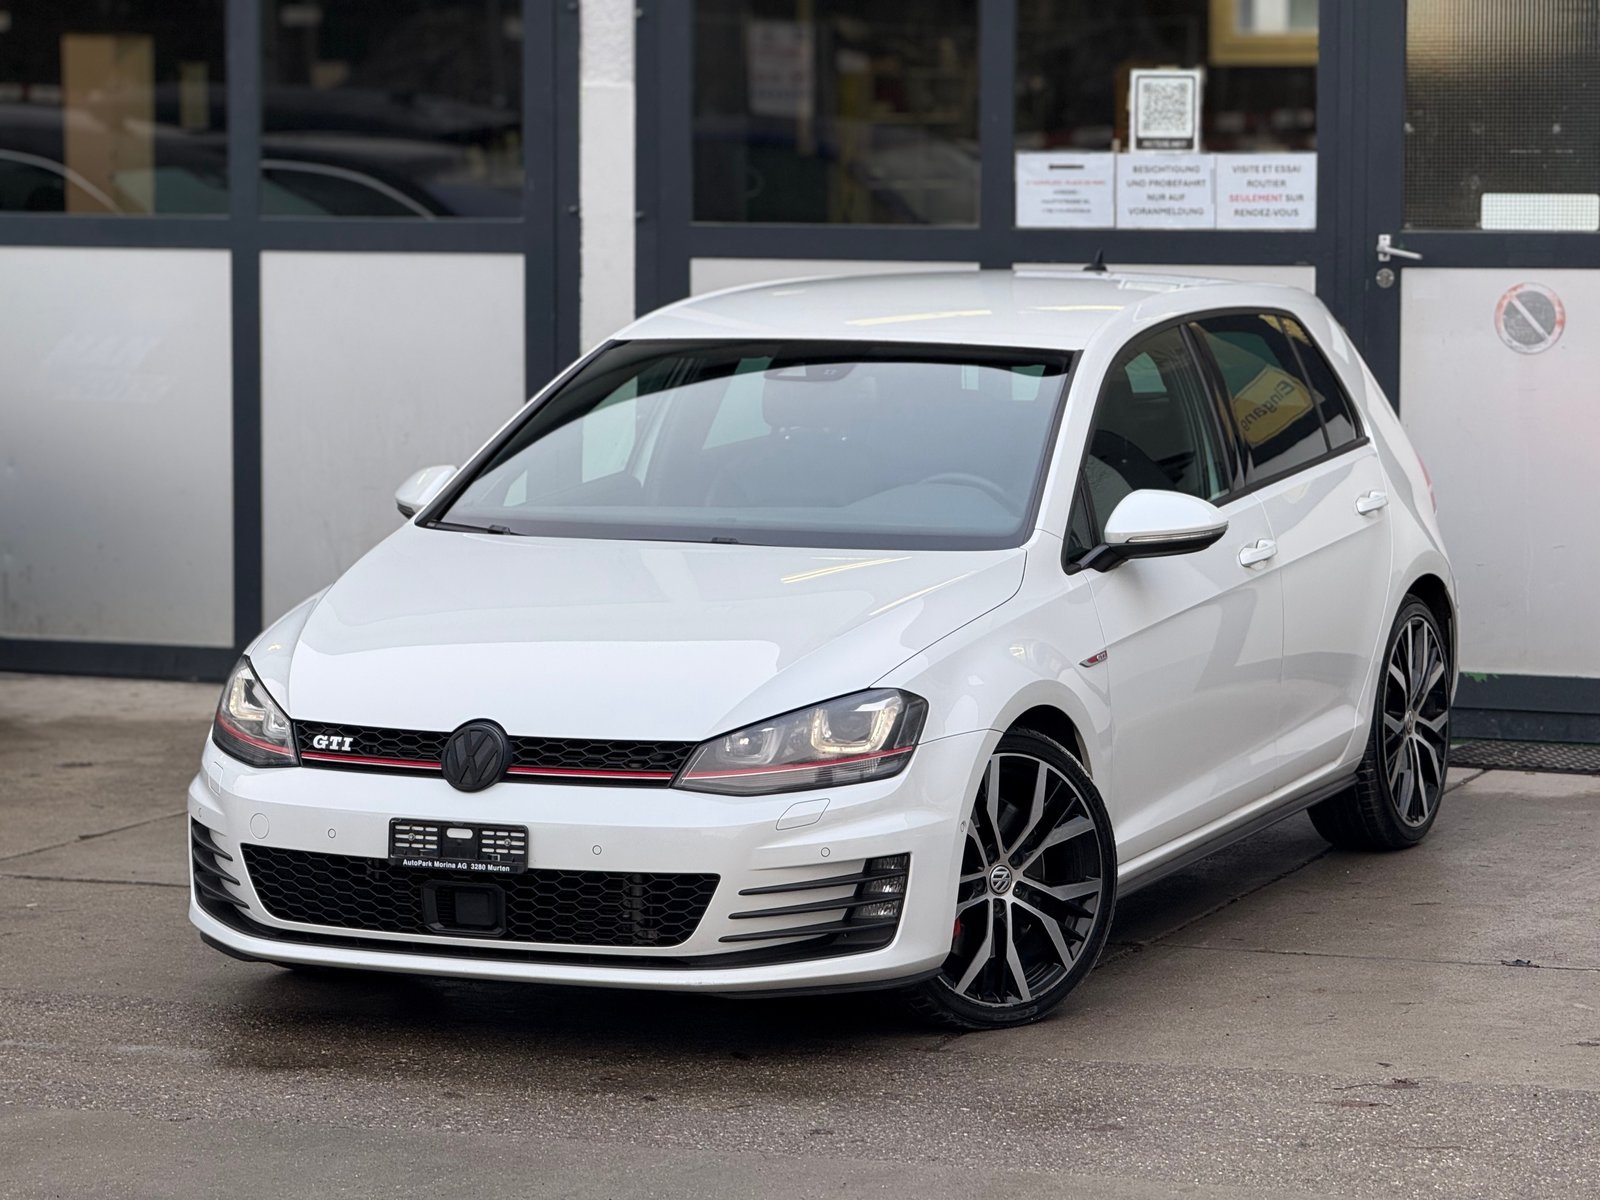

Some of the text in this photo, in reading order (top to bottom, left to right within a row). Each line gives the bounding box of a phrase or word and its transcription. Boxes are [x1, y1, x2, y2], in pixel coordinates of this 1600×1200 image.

[1132, 164, 1201, 174] BESICHTIGUNG
[1231, 164, 1302, 174] VISITE ET ESSAI
[1126, 179, 1207, 188] UND PROBEFAHRT
[1246, 179, 1287, 188] ROUTIER
[1146, 193, 1185, 202] NUR AUF
[1228, 193, 1304, 203] SEULEMENT SUR
[1127, 206, 1205, 216] VORANMELDUNG
[1233, 207, 1300, 217] RENDEZ-VOUS
[312, 734, 354, 751] GTI
[402, 858, 511, 872] AutoPark Morina AG 3280 Murten
